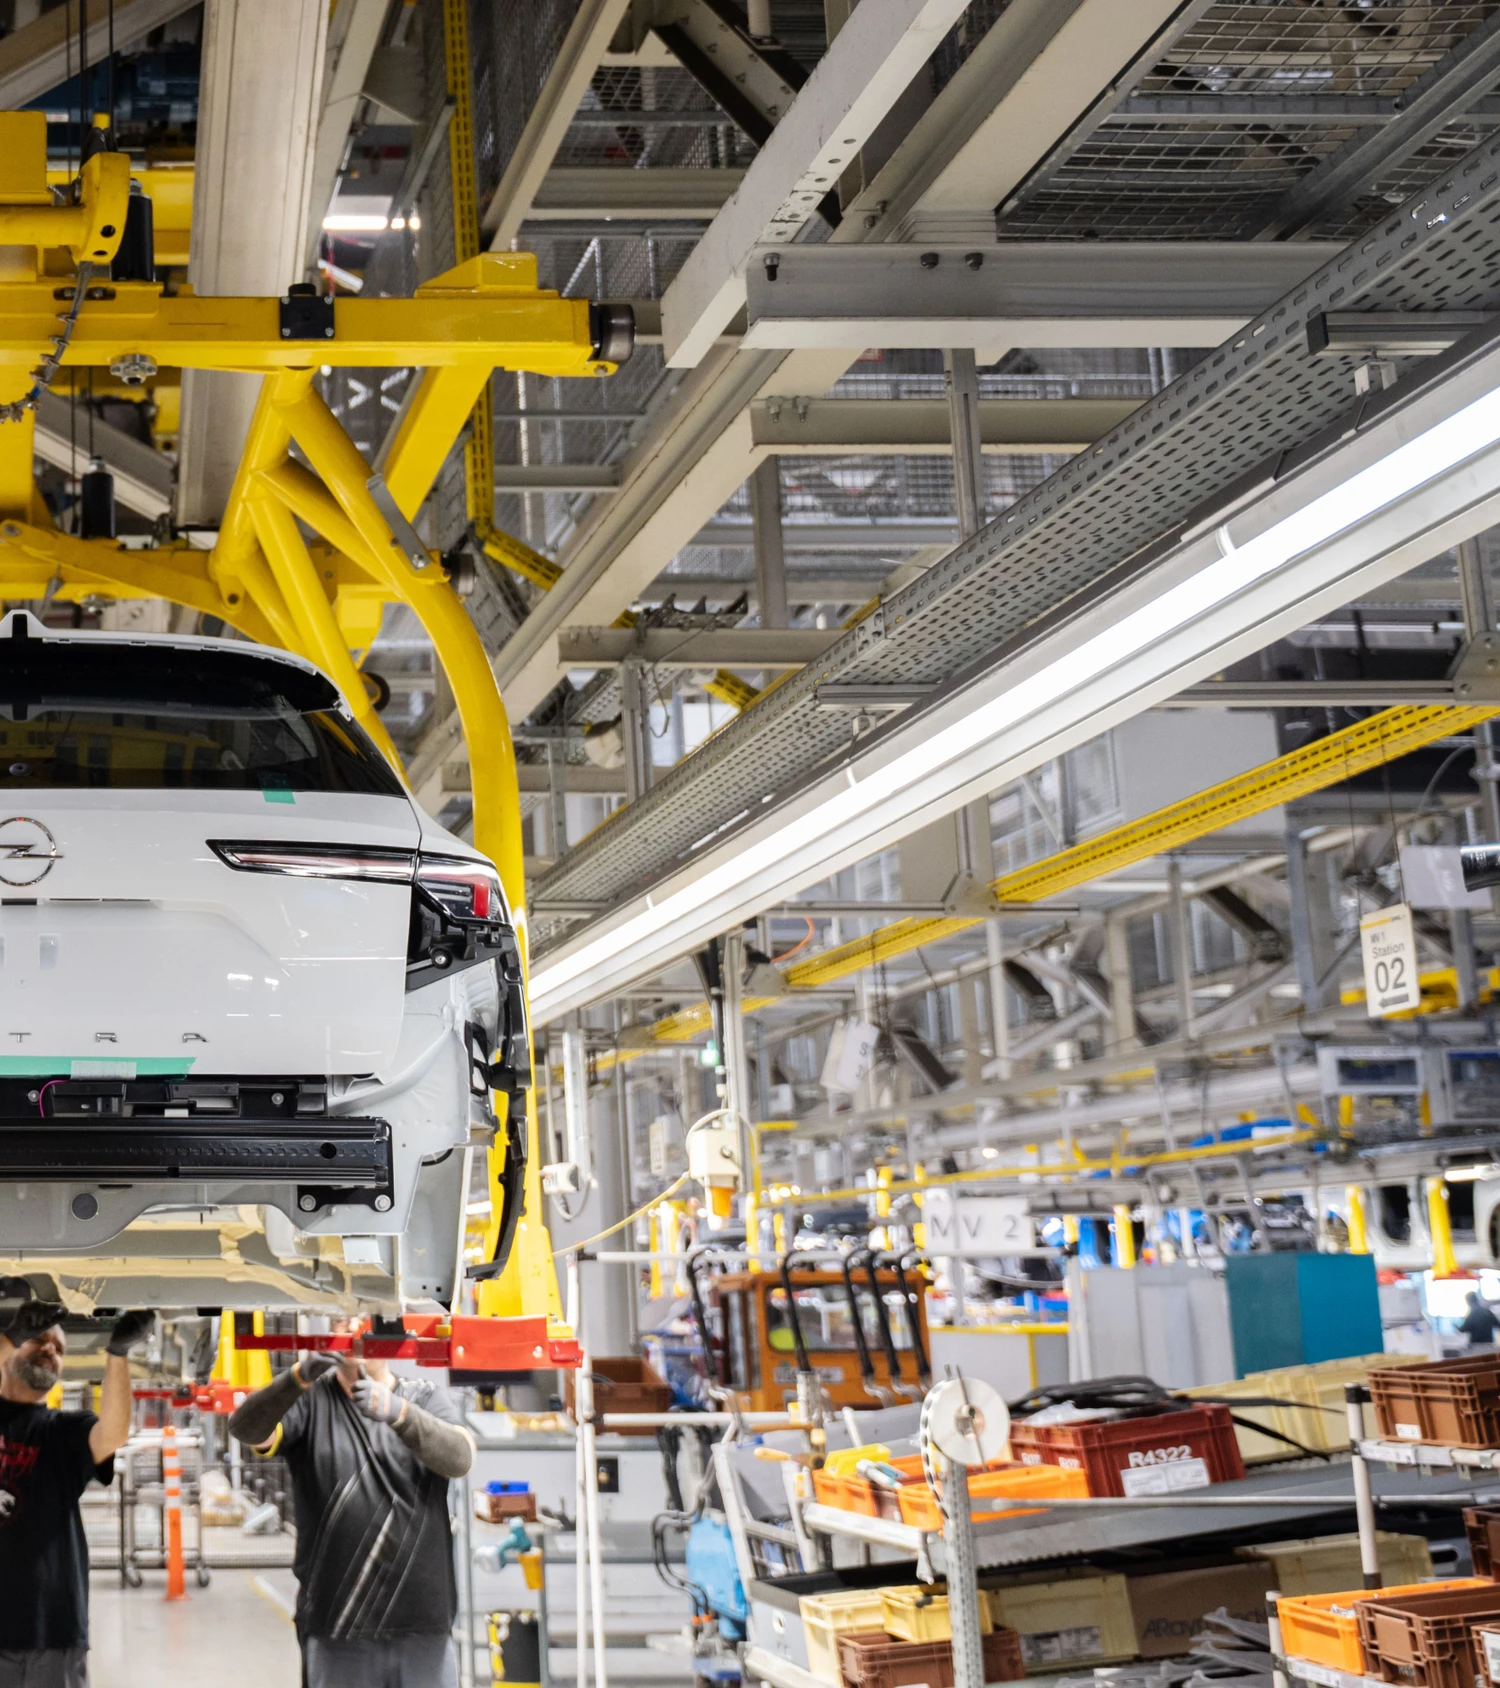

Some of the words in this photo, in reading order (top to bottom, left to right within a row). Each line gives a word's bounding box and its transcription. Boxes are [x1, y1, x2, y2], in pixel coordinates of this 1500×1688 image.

[1371, 942, 1405, 959] Station
[1375, 956, 1407, 993] 02
[1003, 1214, 1018, 1239] 2
[1128, 1444, 1193, 1468] R4322
